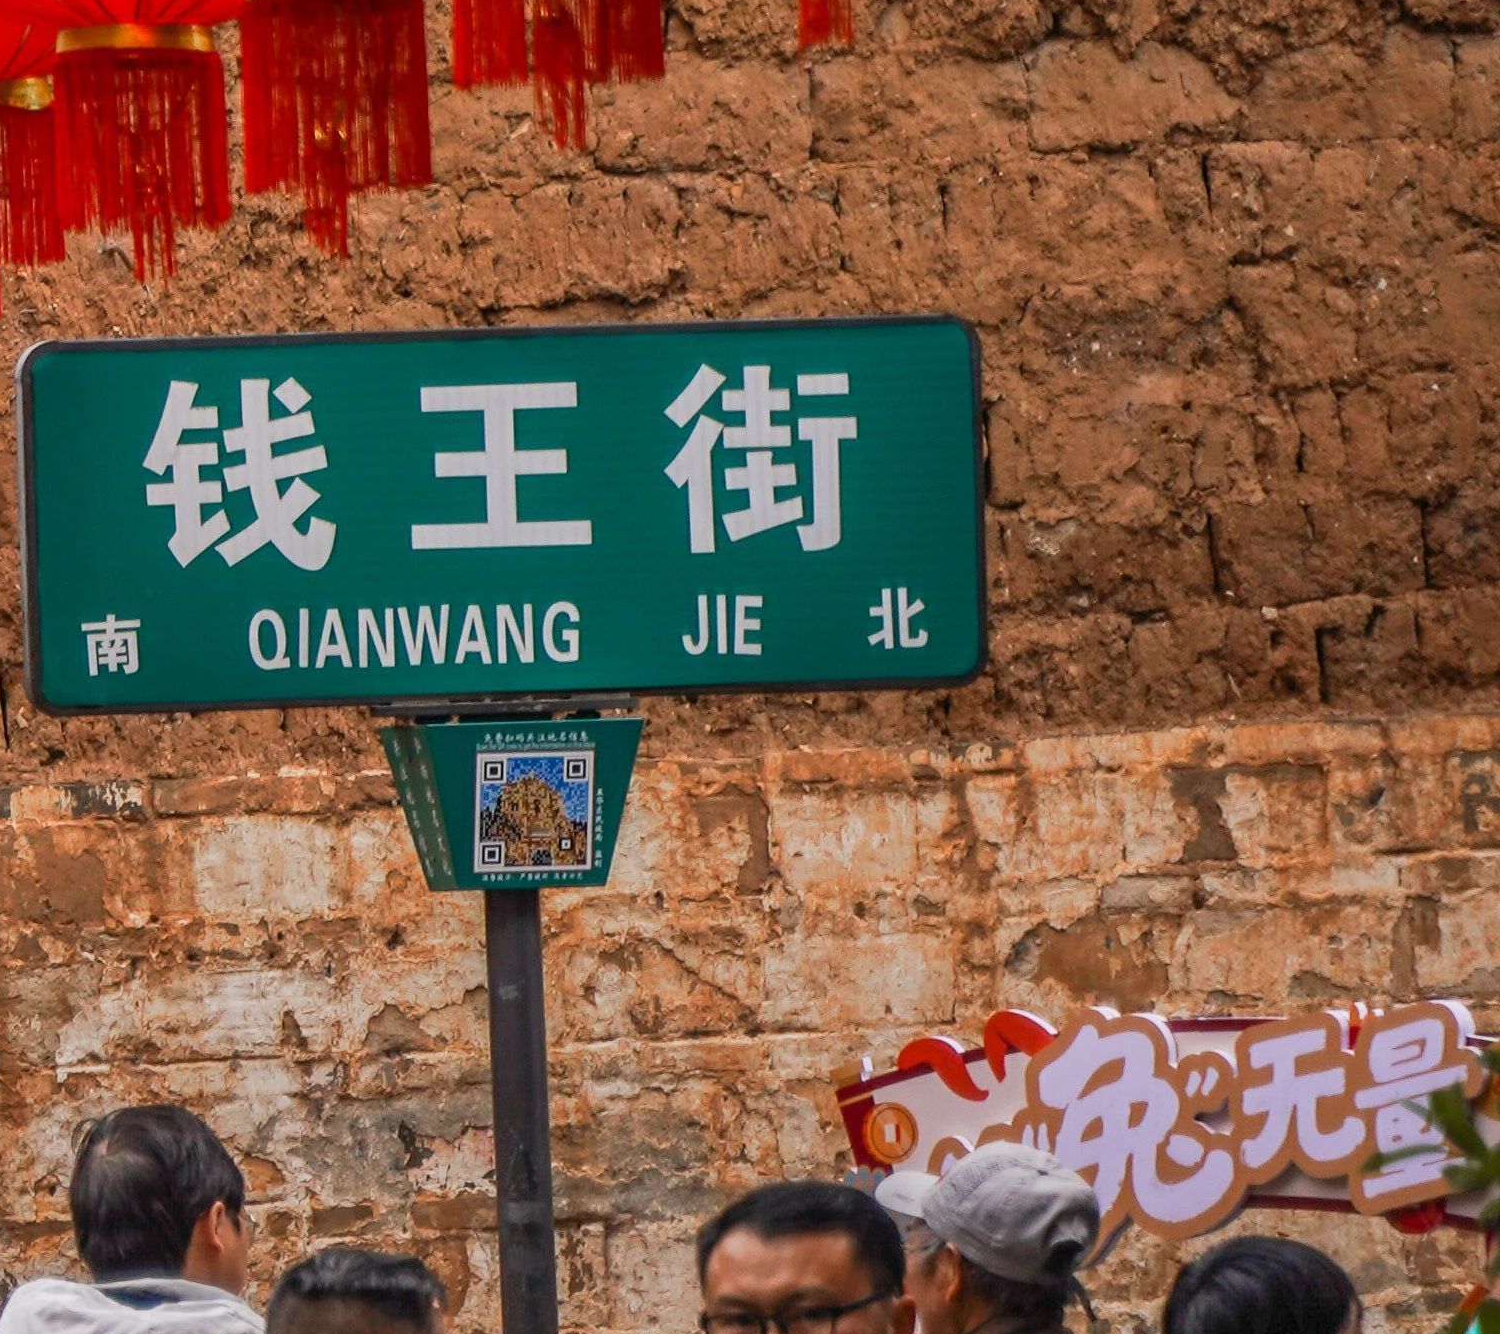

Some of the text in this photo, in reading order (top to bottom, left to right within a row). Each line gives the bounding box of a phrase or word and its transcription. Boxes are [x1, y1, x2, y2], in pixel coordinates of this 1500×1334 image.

[141, 363, 858, 572] 钱王街
[81, 587, 929, 678] 南 QIANWANG JIE 北
